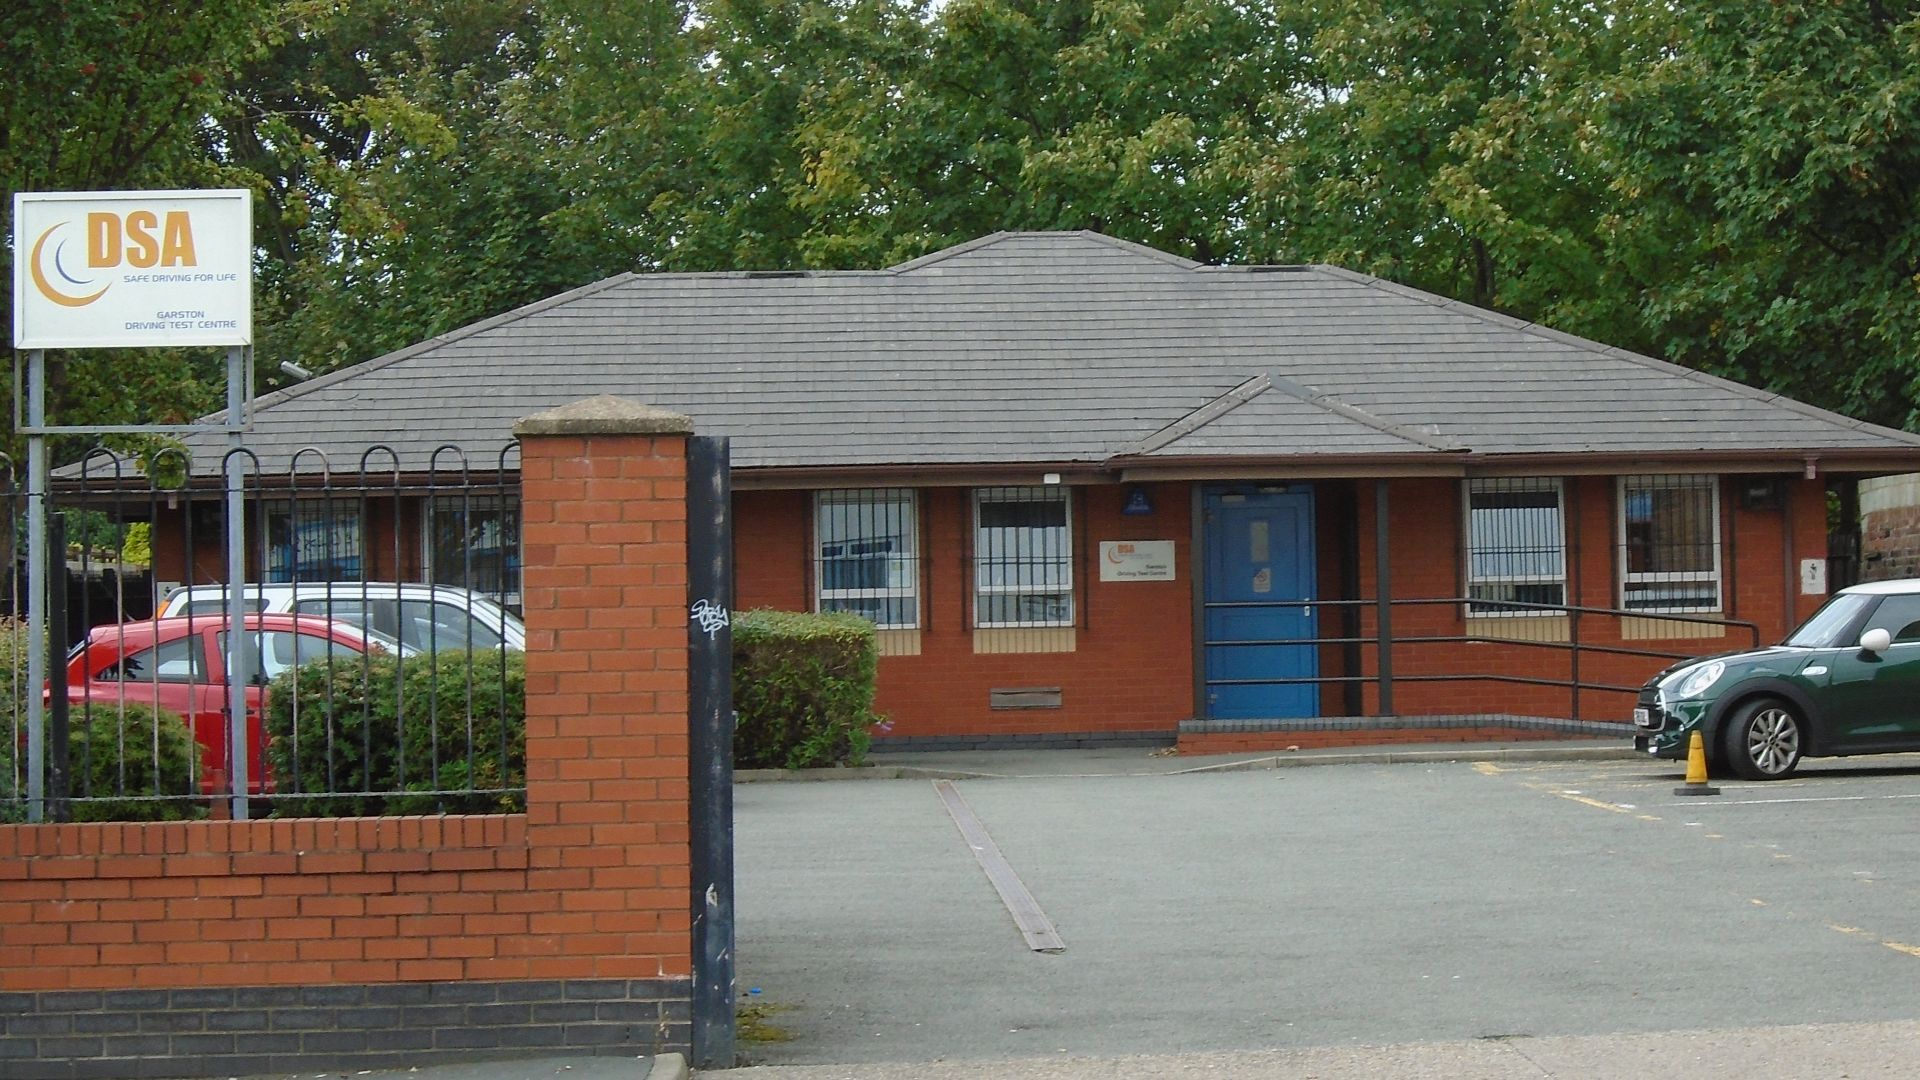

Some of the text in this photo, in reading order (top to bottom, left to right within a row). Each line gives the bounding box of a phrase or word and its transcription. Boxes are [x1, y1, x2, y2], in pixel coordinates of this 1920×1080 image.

[88, 210, 197, 269] DSA
[123, 273, 237, 283] SAFE DRIVING FOR LIFE
[156, 310, 205, 319] GARSTON
[125, 320, 237, 330] DRIVING TEST CENTRE
